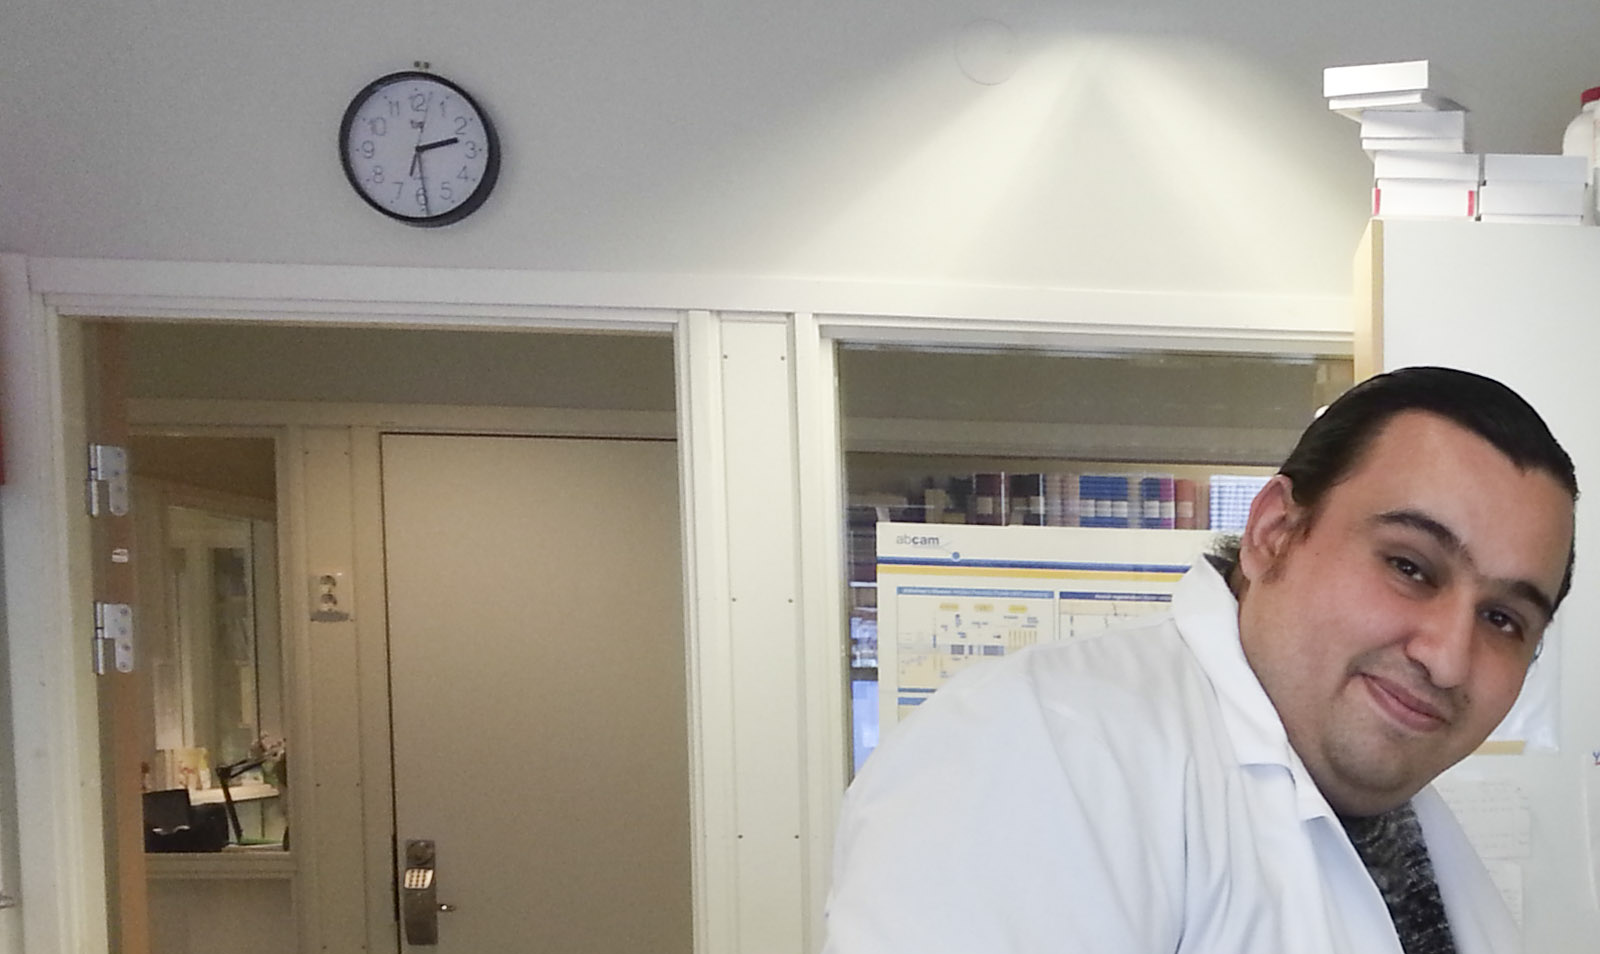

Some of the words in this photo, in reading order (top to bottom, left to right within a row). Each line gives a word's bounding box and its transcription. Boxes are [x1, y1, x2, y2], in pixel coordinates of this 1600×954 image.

[408, 93, 426, 113] 12
[368, 117, 387, 136] 10
[454, 116, 468, 135] 2
[361, 140, 375, 159] 9
[465, 141, 478, 160] 3
[372, 165, 385, 184] 8
[456, 165, 470, 182] 4
[391, 181, 404, 200] 7
[439, 181, 453, 200] 5
[895, 533, 940, 546] abcam
